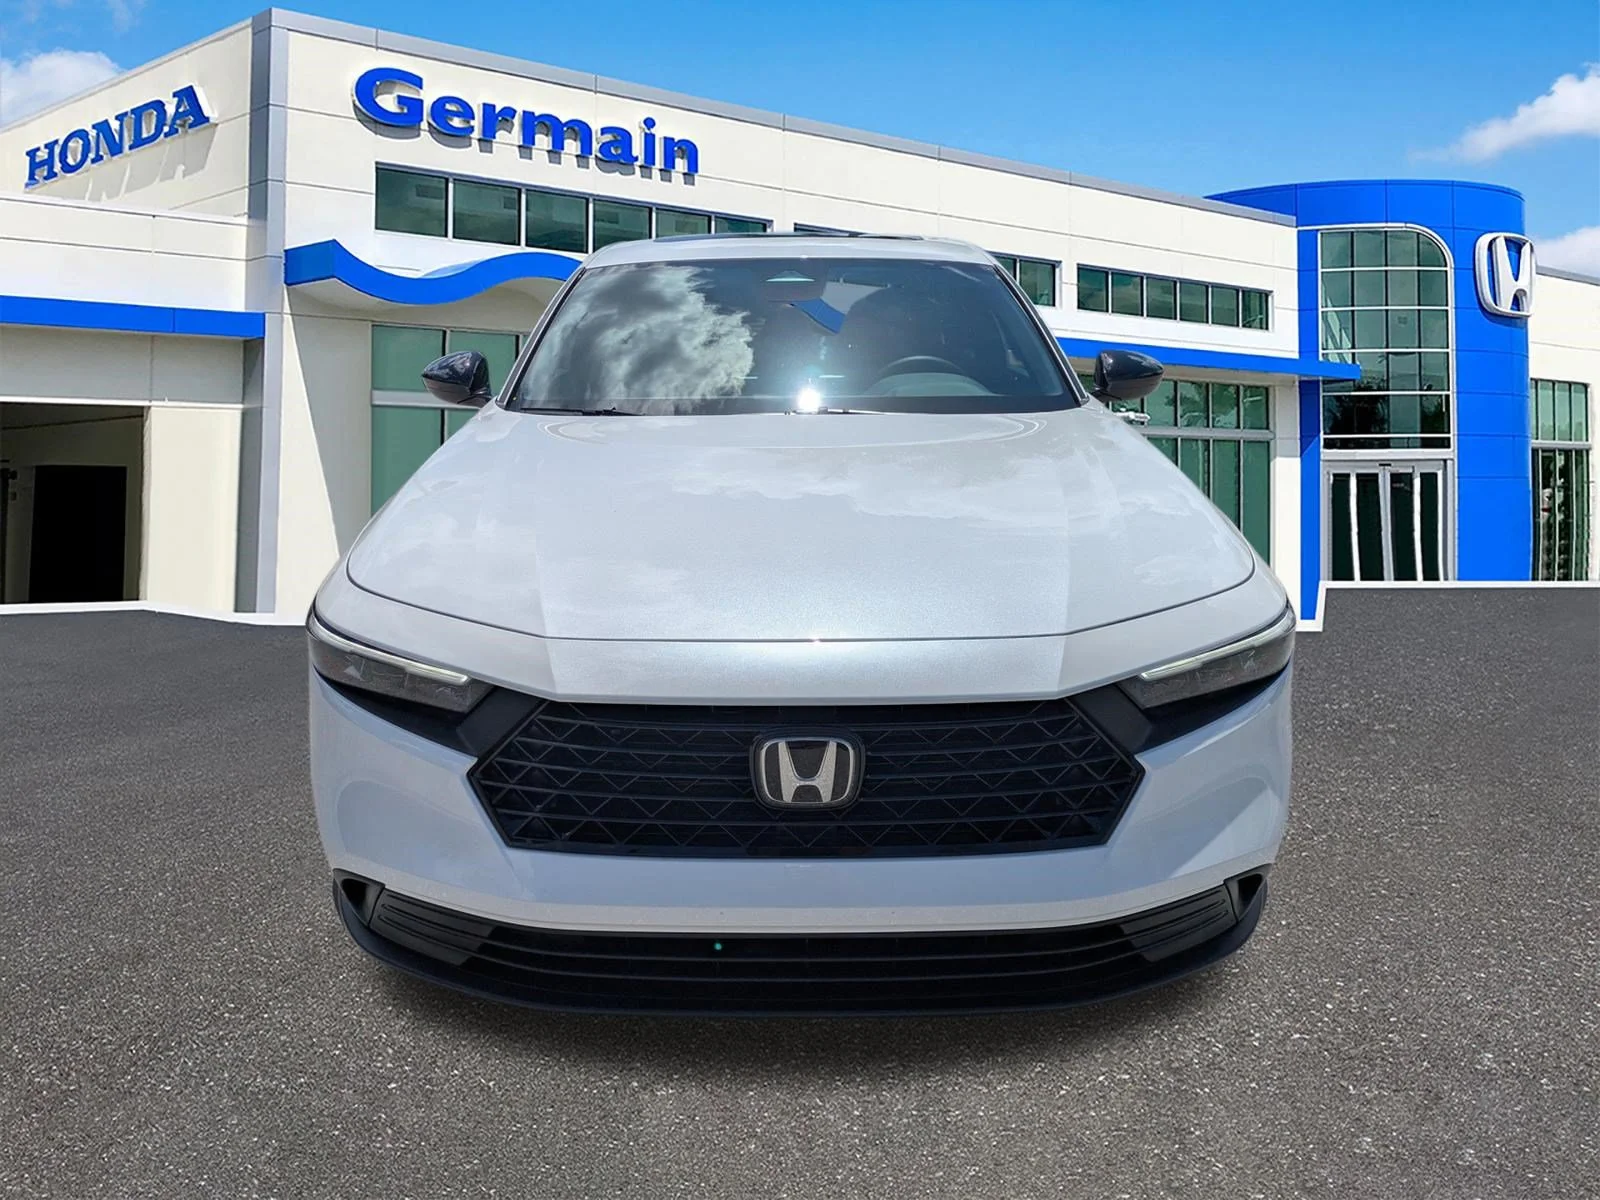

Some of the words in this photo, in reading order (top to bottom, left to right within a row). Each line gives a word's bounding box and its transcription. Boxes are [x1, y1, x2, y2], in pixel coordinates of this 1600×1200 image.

[25, 84, 210, 189] HONDA
[353, 67, 699, 174] Germain
[777, 739, 838, 804] H
